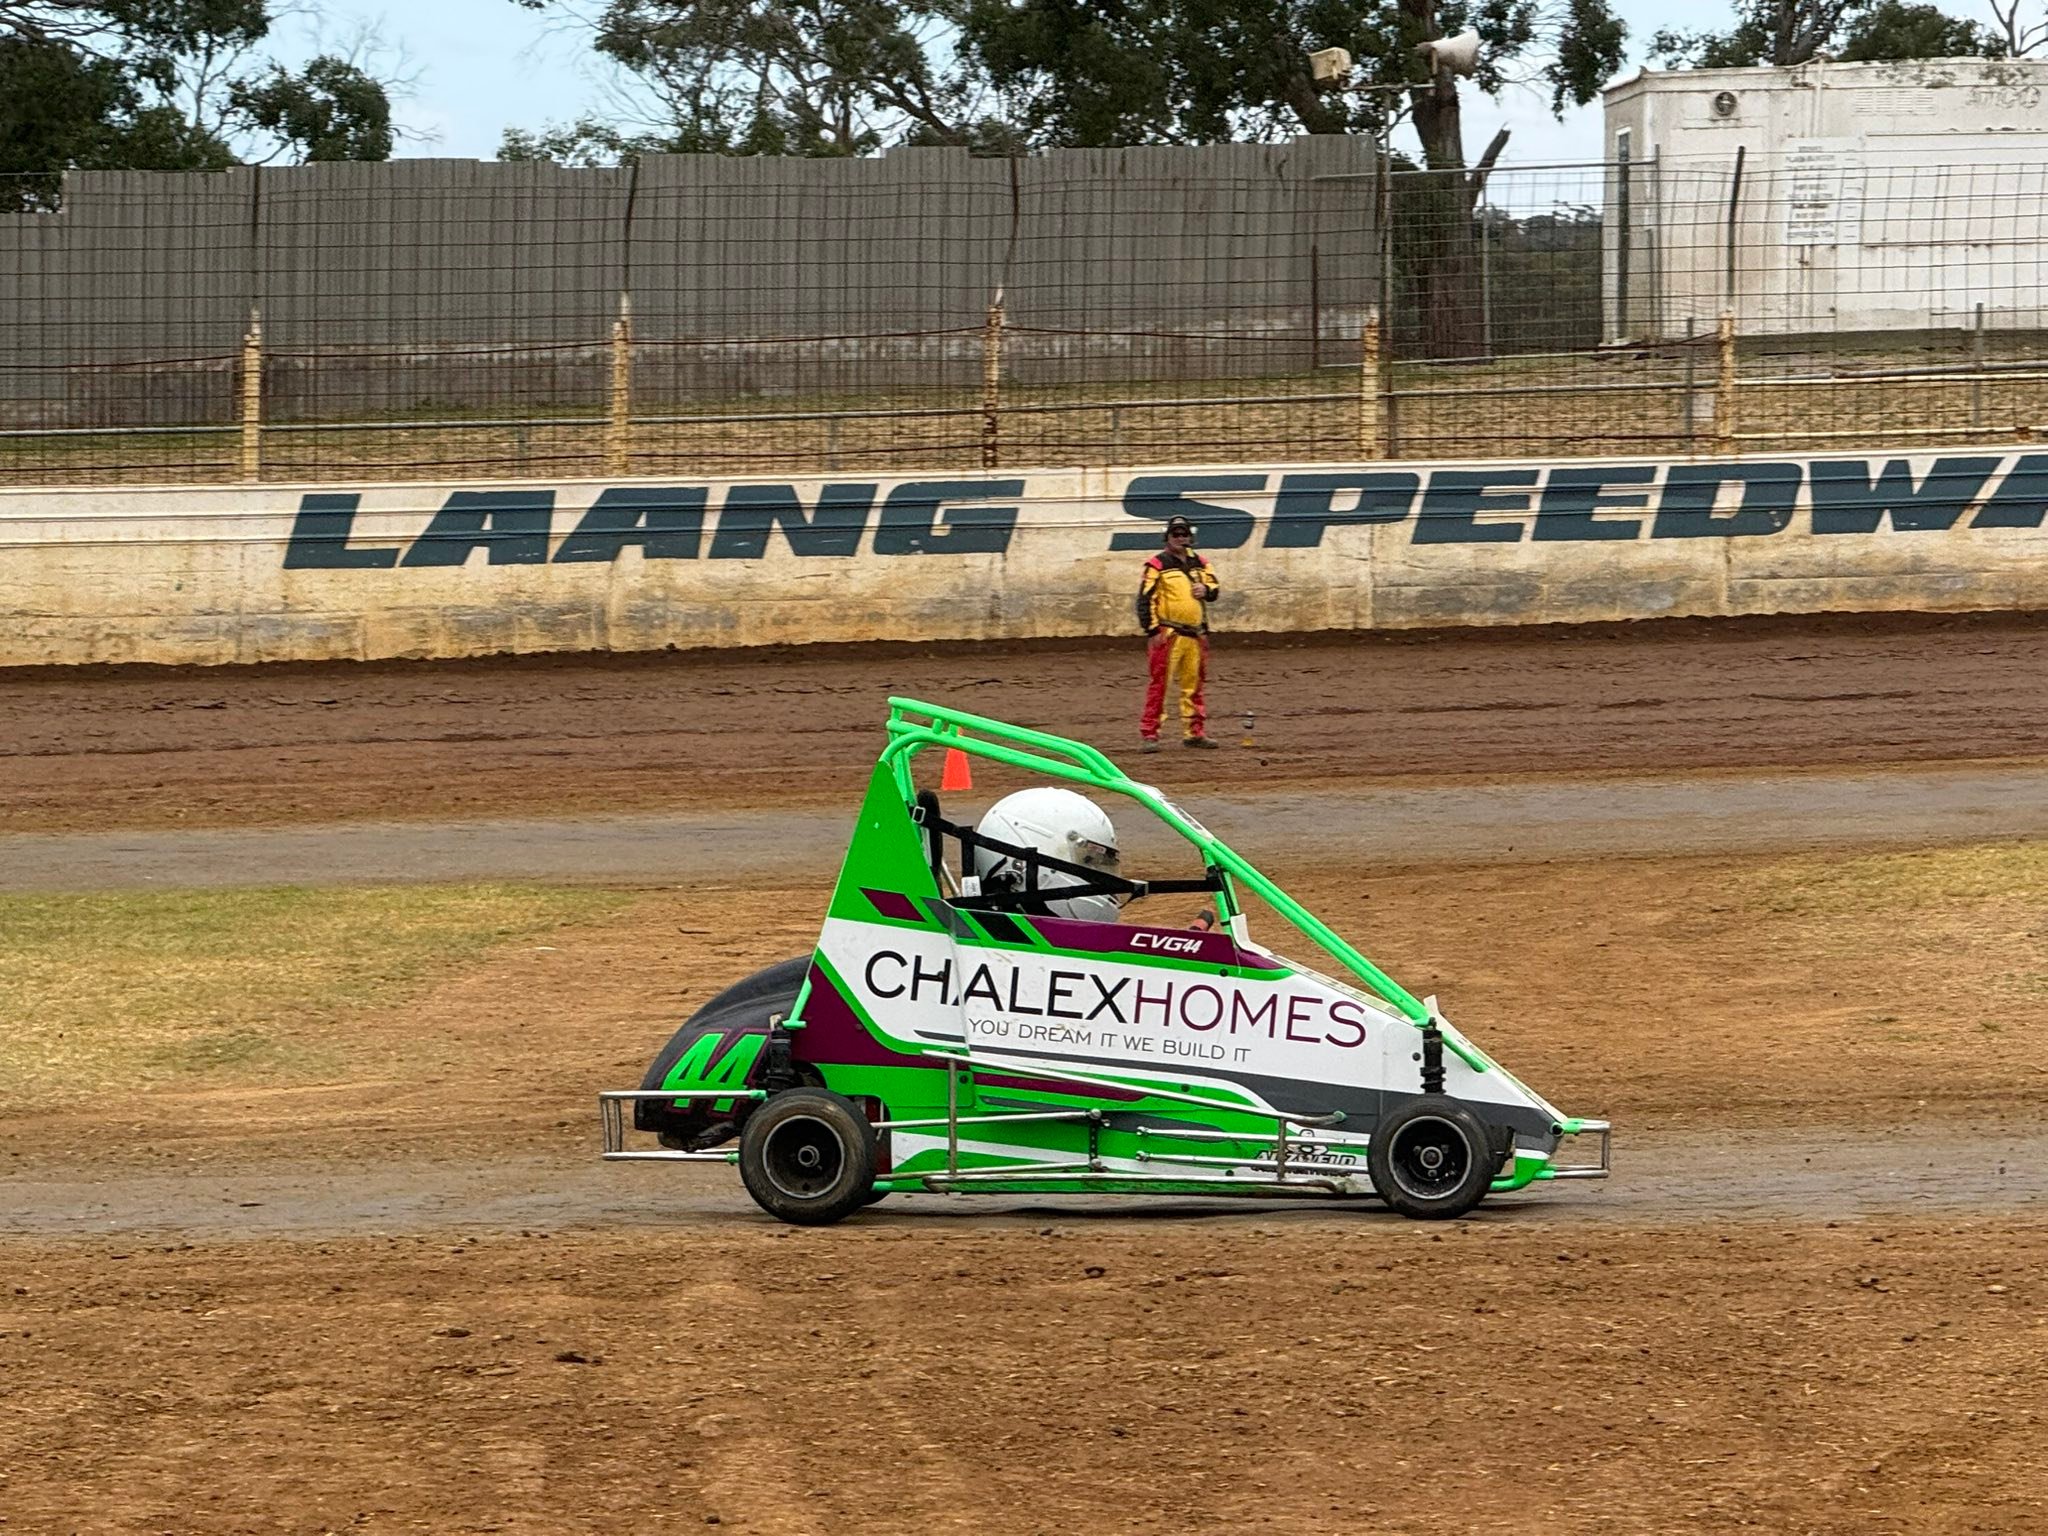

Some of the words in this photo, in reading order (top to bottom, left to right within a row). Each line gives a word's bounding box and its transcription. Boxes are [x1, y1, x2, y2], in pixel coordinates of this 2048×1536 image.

[283, 479, 1025, 569] LAANG
[1129, 932, 1204, 954] CVG44
[660, 1031, 770, 1114] 44
[968, 1018, 1009, 1036] YOU
[1018, 1022, 1092, 1046] DREAM
[1101, 1033, 1118, 1048] IT
[1123, 1035, 1154, 1053] WE
[1163, 1039, 1226, 1061] BUILD
[1234, 1047, 1252, 1063] IT
